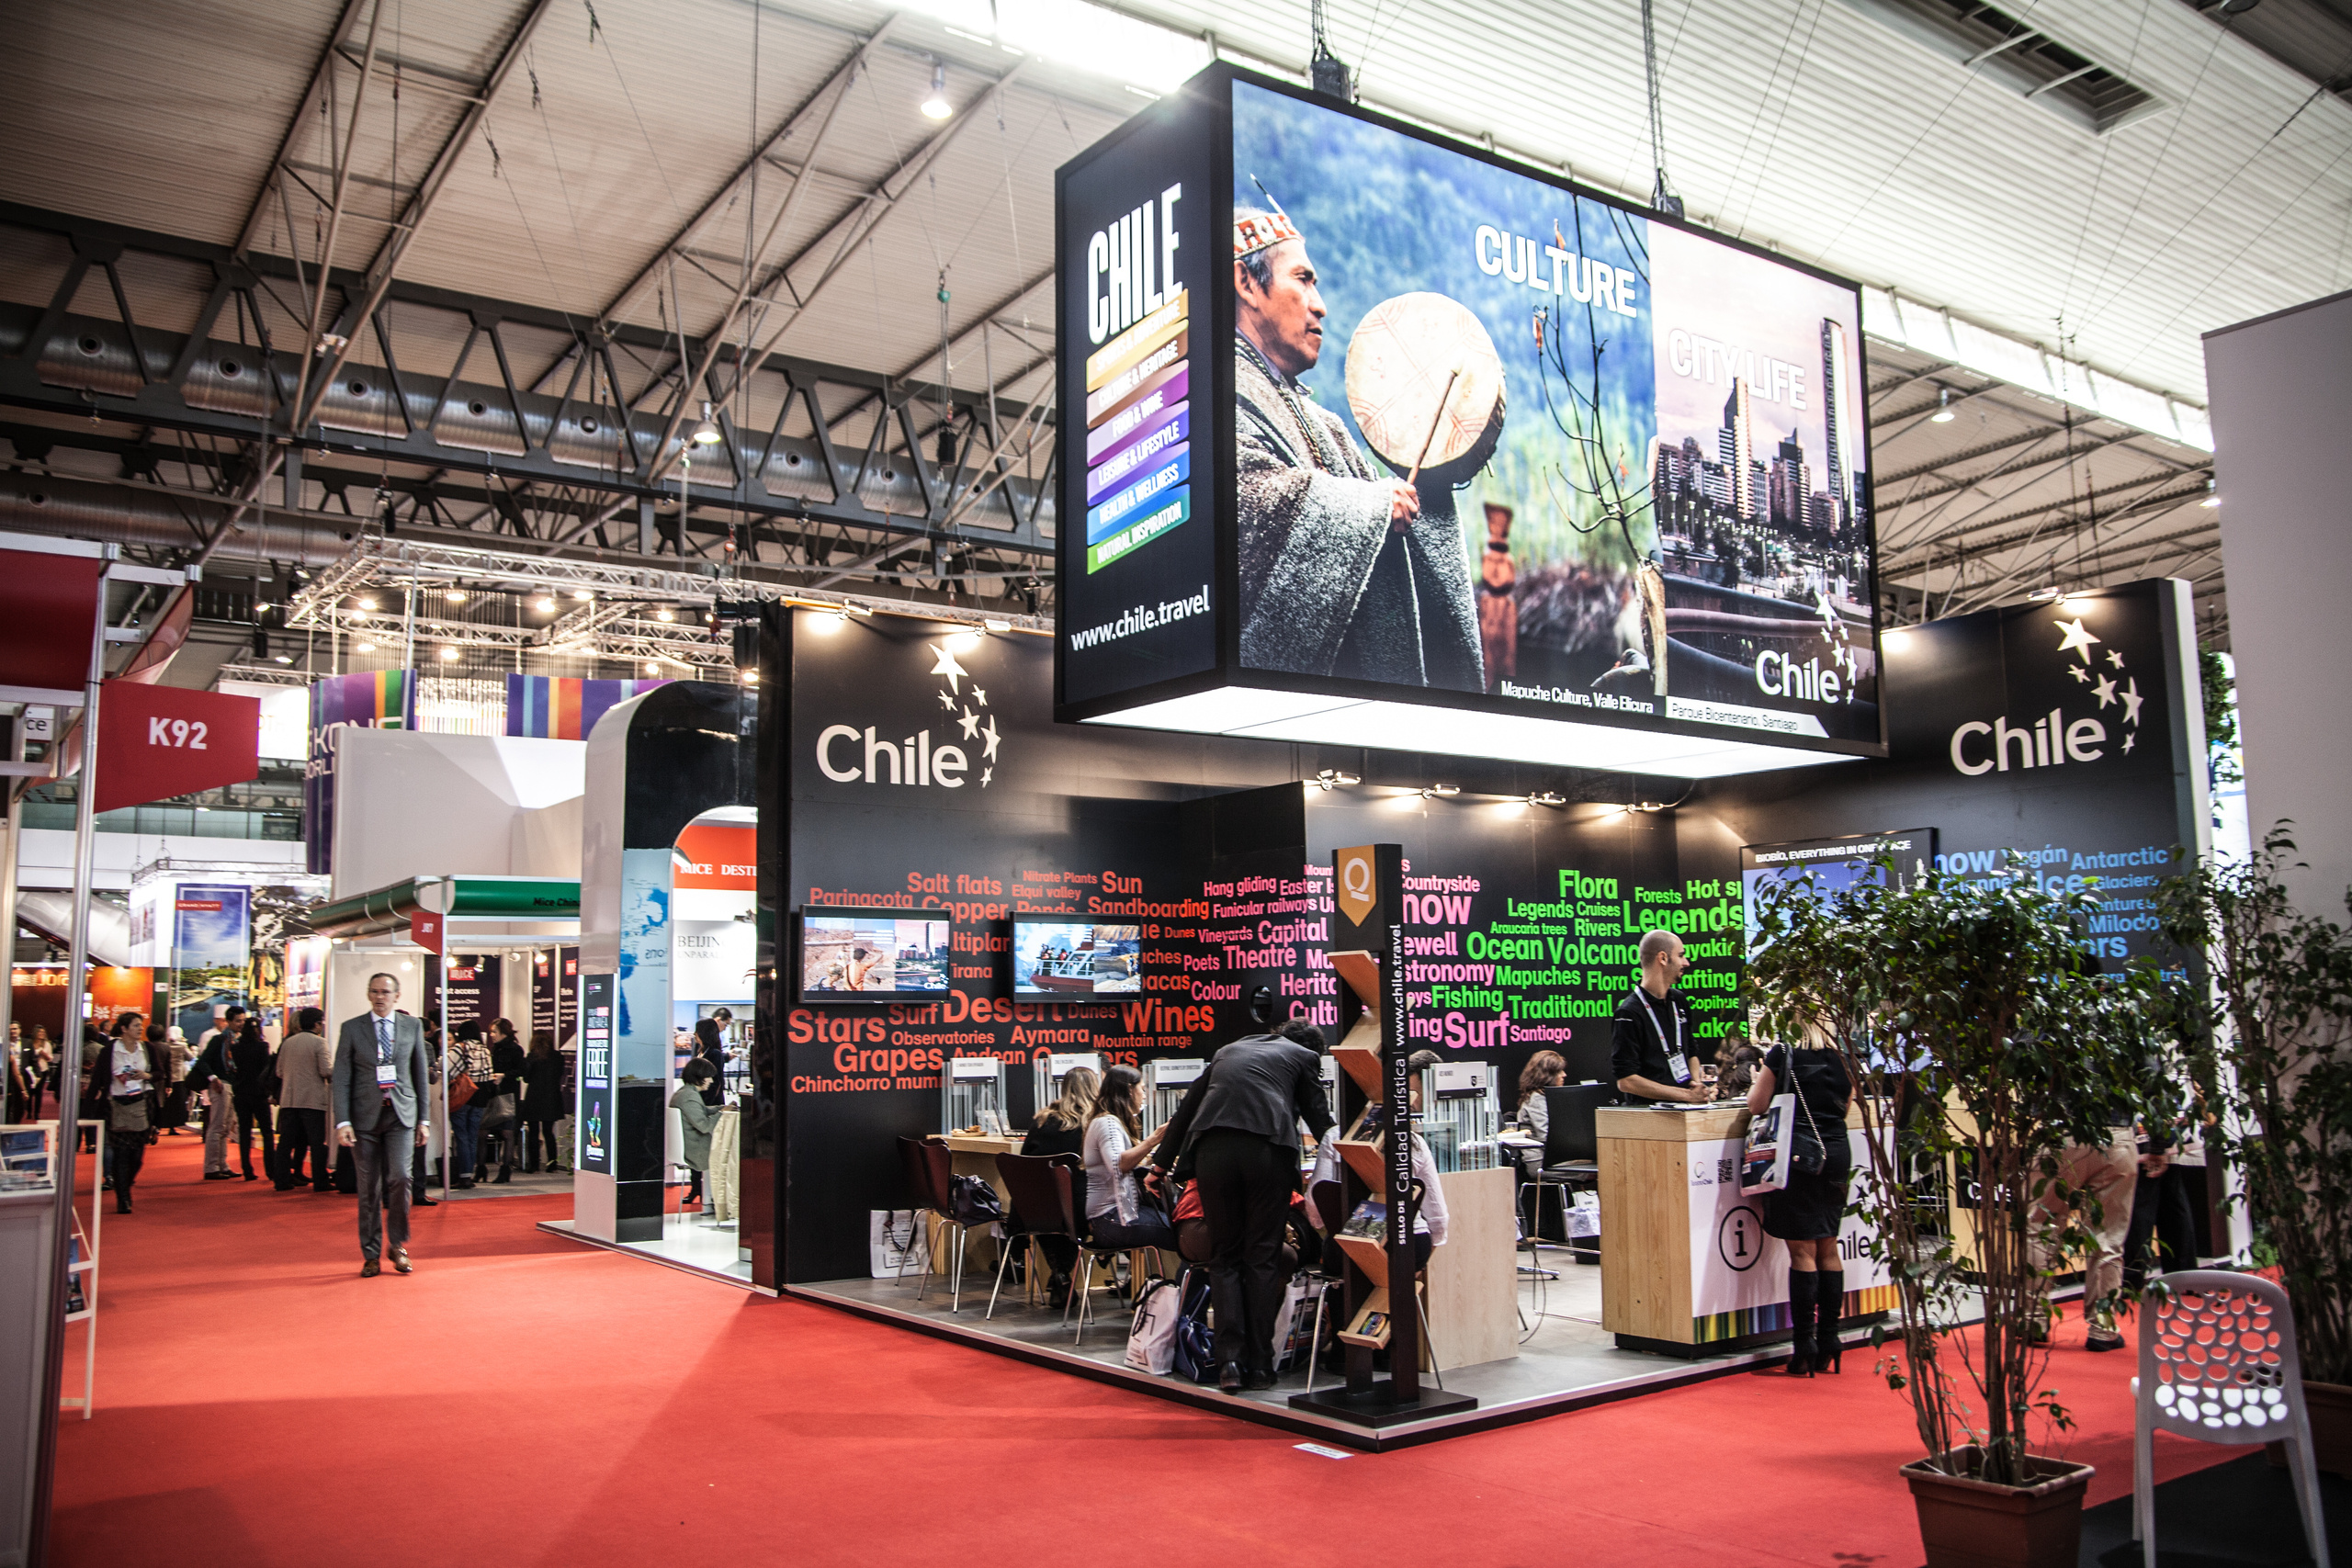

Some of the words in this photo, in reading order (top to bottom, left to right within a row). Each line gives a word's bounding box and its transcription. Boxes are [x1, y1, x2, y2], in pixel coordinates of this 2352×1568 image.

[1088, 183, 1183, 344] CHILE
[1475, 224, 1637, 319] CULTURE
[1139, 339, 1179, 380] HERITAGE
[1668, 328, 1739, 390] CITY
[1747, 350, 1807, 412] LIFE
[1112, 410, 1134, 438] FOOD
[1140, 389, 1164, 419] WINE
[1098, 450, 1130, 487] LEISURE
[1136, 420, 1180, 462] LIFESTYLE
[1099, 491, 1127, 525] HEALTH
[1127, 489, 1136, 508] &
[1135, 463, 1180, 503] WELLNESS
[1097, 530, 1132, 564] NATURAL
[1131, 501, 1183, 545] INSPIRATION
[1071, 584, 1211, 651] www.chile.travel
[1755, 649, 1841, 704] Chile
[1501, 680, 1551, 701] Mapuche
[1551, 687, 1593, 708] Culture,
[1592, 692, 1619, 710] Valle
[1619, 695, 1654, 714] Elicura
[1672, 697, 1704, 720] Parque
[1705, 706, 1760, 728] Bicentenario,
[1762, 713, 1798, 732] Santiago
[149, 716, 208, 750] K92
[1951, 707, 2107, 776] Chile
[816, 724, 968, 788] Chile
[1789, 846, 1846, 860] EVERYTHING
[1846, 844, 1858, 855] IN
[2070, 845, 2169, 871] Antarctic
[907, 872, 950, 894] Salt
[956, 874, 1002, 896] flats
[1023, 870, 1060, 883] Nitrate
[1063, 872, 1098, 885] Plants
[1102, 871, 1143, 894] Sun
[1204, 881, 1234, 897] Hang
[1237, 875, 1277, 896] gliding
[1280, 878, 1323, 896] Easter
[1344, 857, 1370, 901] Q
[1402, 874, 1481, 894] ountryside
[1559, 869, 1618, 899] Flora
[1686, 879, 1721, 899] Hot
[2092, 874, 2159, 890] Glaciers
[1012, 885, 1043, 899] Elqui
[1046, 886, 1081, 901] valley
[1634, 886, 1682, 904] Forests
[1088, 896, 1209, 919] Sandboarding
[1213, 899, 1264, 919] Funicular
[1267, 897, 1317, 915] railways
[1508, 897, 1575, 921] Legends
[1576, 901, 1621, 917] Cruises
[1623, 898, 1744, 934] Legends
[1164, 927, 1195, 939] Dunes
[1198, 926, 1253, 944] Vineyards
[1258, 917, 1329, 948] Capital
[1490, 921, 1540, 935] Araucaria
[1542, 922, 1567, 935] trees
[1575, 919, 1622, 937] Rivers
[1223, 943, 1296, 969] Theatre
[1466, 931, 1544, 961] Ocean
[1184, 954, 1220, 972] Poets
[1389, 924, 1407, 1046] www.chile.travel
[1496, 965, 1581, 989] Mapuches
[1587, 971, 1629, 991] Flora
[1191, 980, 1241, 1001] Colour
[1431, 985, 1503, 1012] Fishing
[888, 1002, 939, 1025] Surf
[1067, 1003, 1118, 1020] Dunes
[1120, 998, 1216, 1033] Wines
[1508, 994, 1614, 1020] Traditional
[787, 1009, 887, 1044] Stars
[891, 1031, 995, 1046] Observatories
[1011, 1025, 1090, 1048] Aymara
[1444, 1010, 1510, 1049] Surf
[1510, 1024, 1572, 1043] Santiago
[1093, 1034, 1154, 1049] Mountain
[1158, 1035, 1193, 1049] range
[833, 1043, 944, 1077] Grapes
[790, 1076, 891, 1093] Chinchorro
[1394, 1058, 1407, 1124] Turística
[1396, 1130, 1409, 1193] Calidad
[1397, 1200, 1407, 1213] DE
[1398, 1215, 1407, 1245] SELLO
